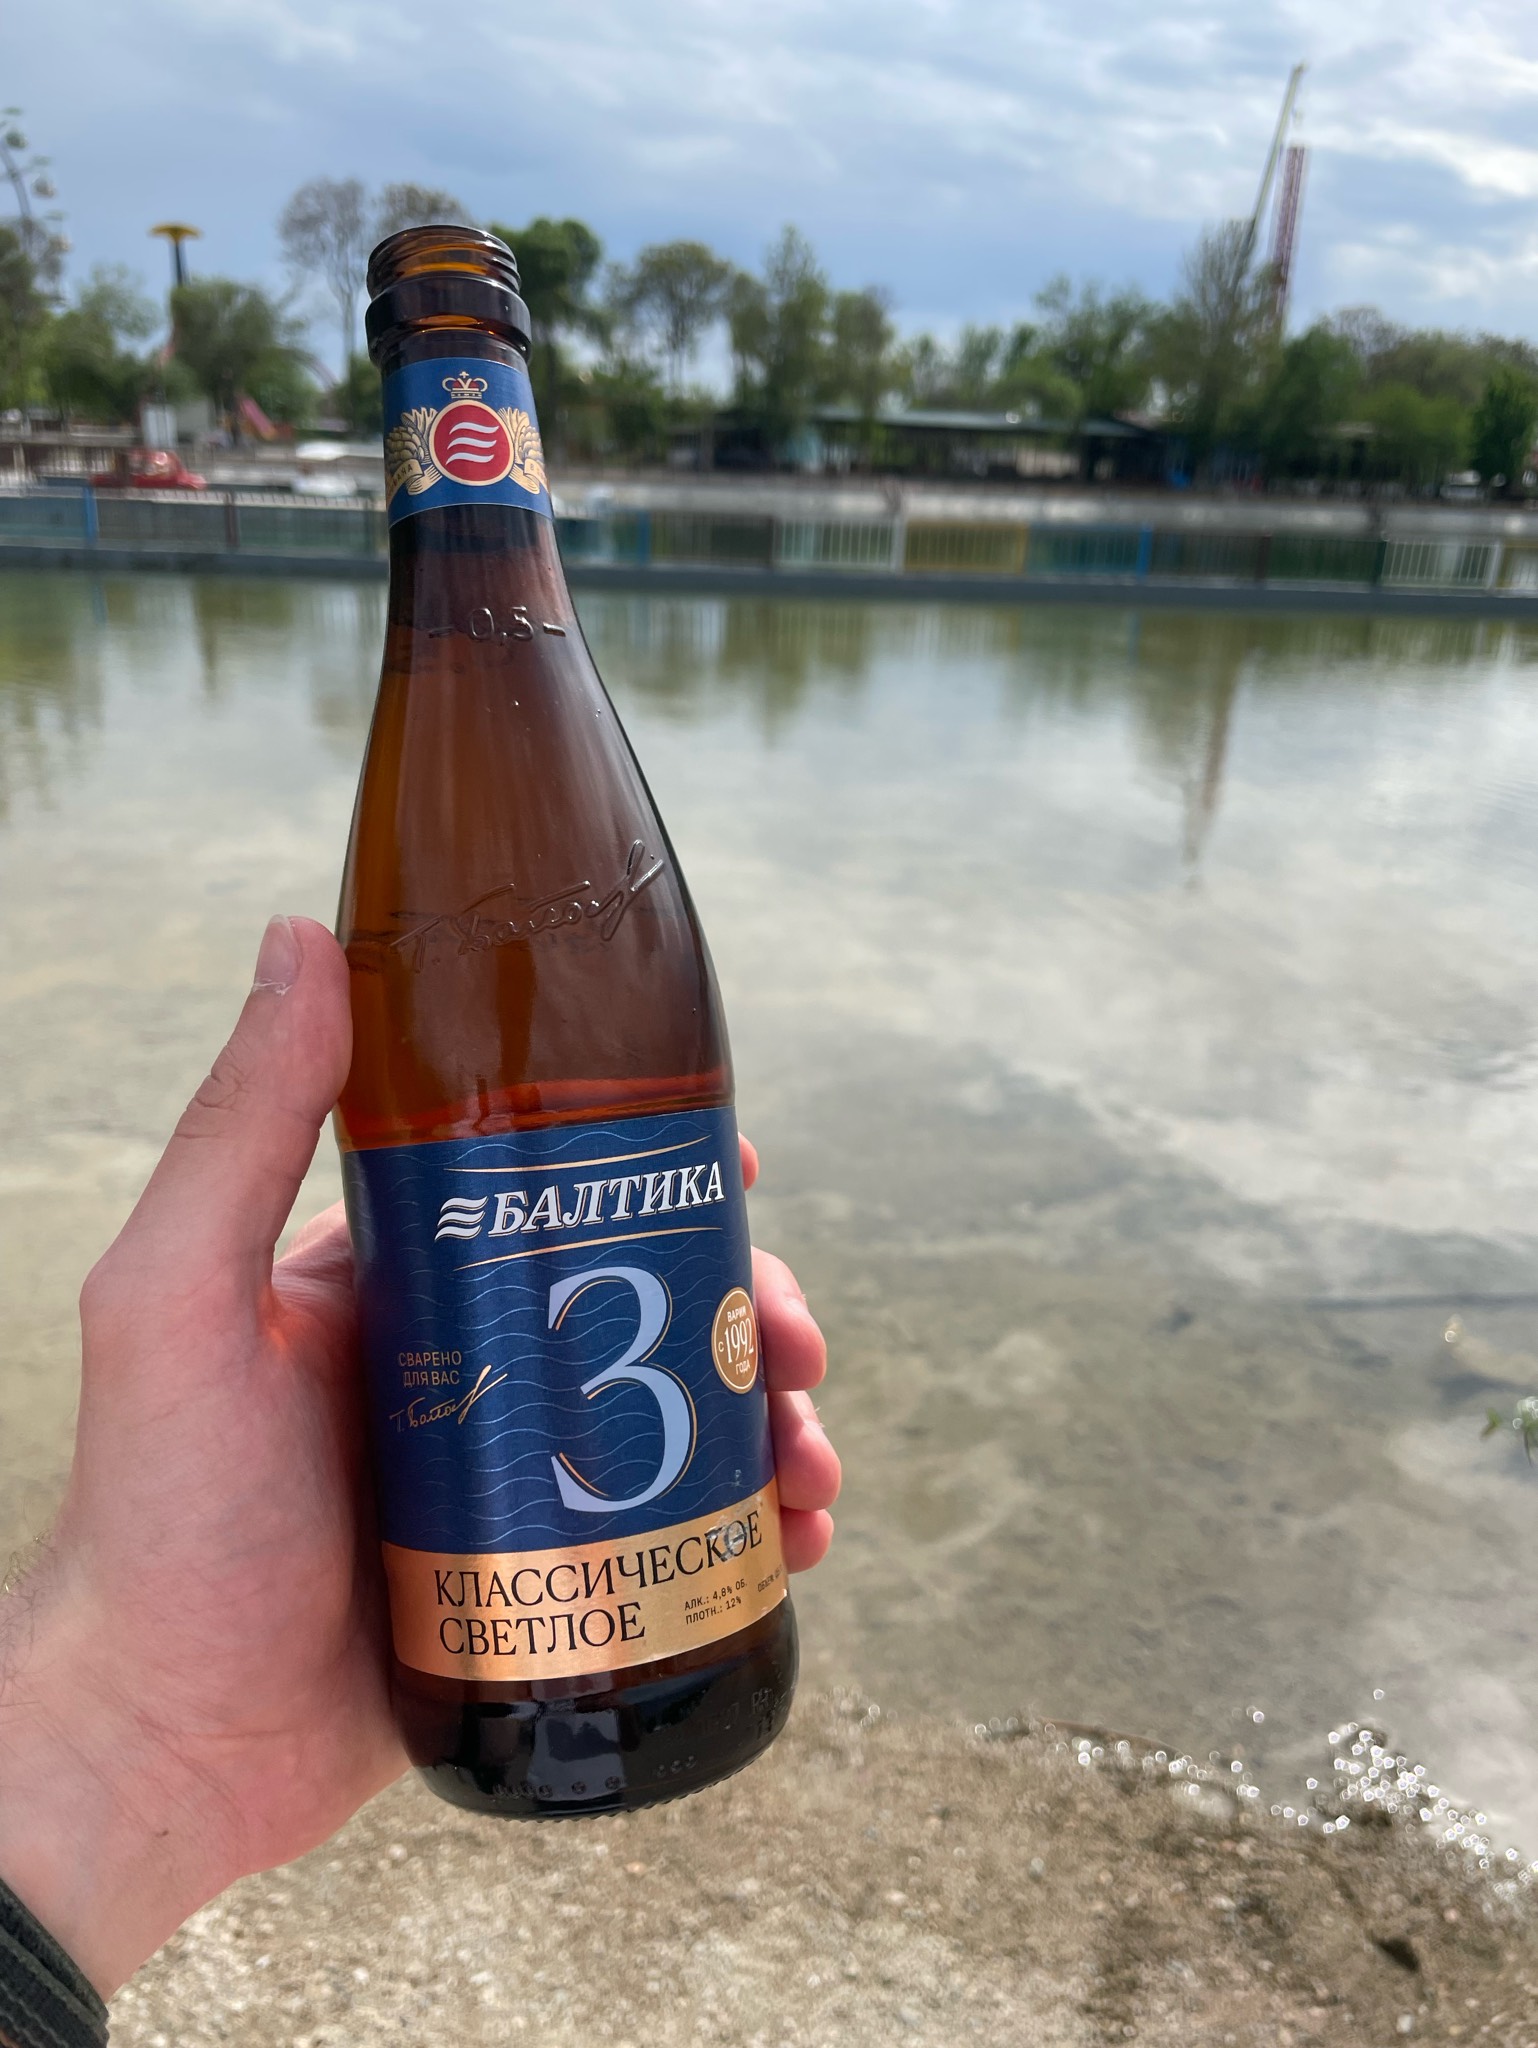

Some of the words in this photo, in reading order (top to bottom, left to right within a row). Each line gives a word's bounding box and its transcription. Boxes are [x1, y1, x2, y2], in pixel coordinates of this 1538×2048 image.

[488, 1161, 726, 1238] БАЛТИКА
[398, 1350, 462, 1367] СВАРЕНО
[724, 1317, 754, 1364] 1992
[403, 1371, 429, 1388] ДЛЯ
[431, 1370, 460, 1386] ВАС
[548, 1266, 697, 1513] 3
[434, 1510, 762, 1607] КЛАССИЧЕСКОЕ
[726, 1595, 742, 1610] 12%
[439, 1602, 646, 1655] СВЕТЛОЕ
